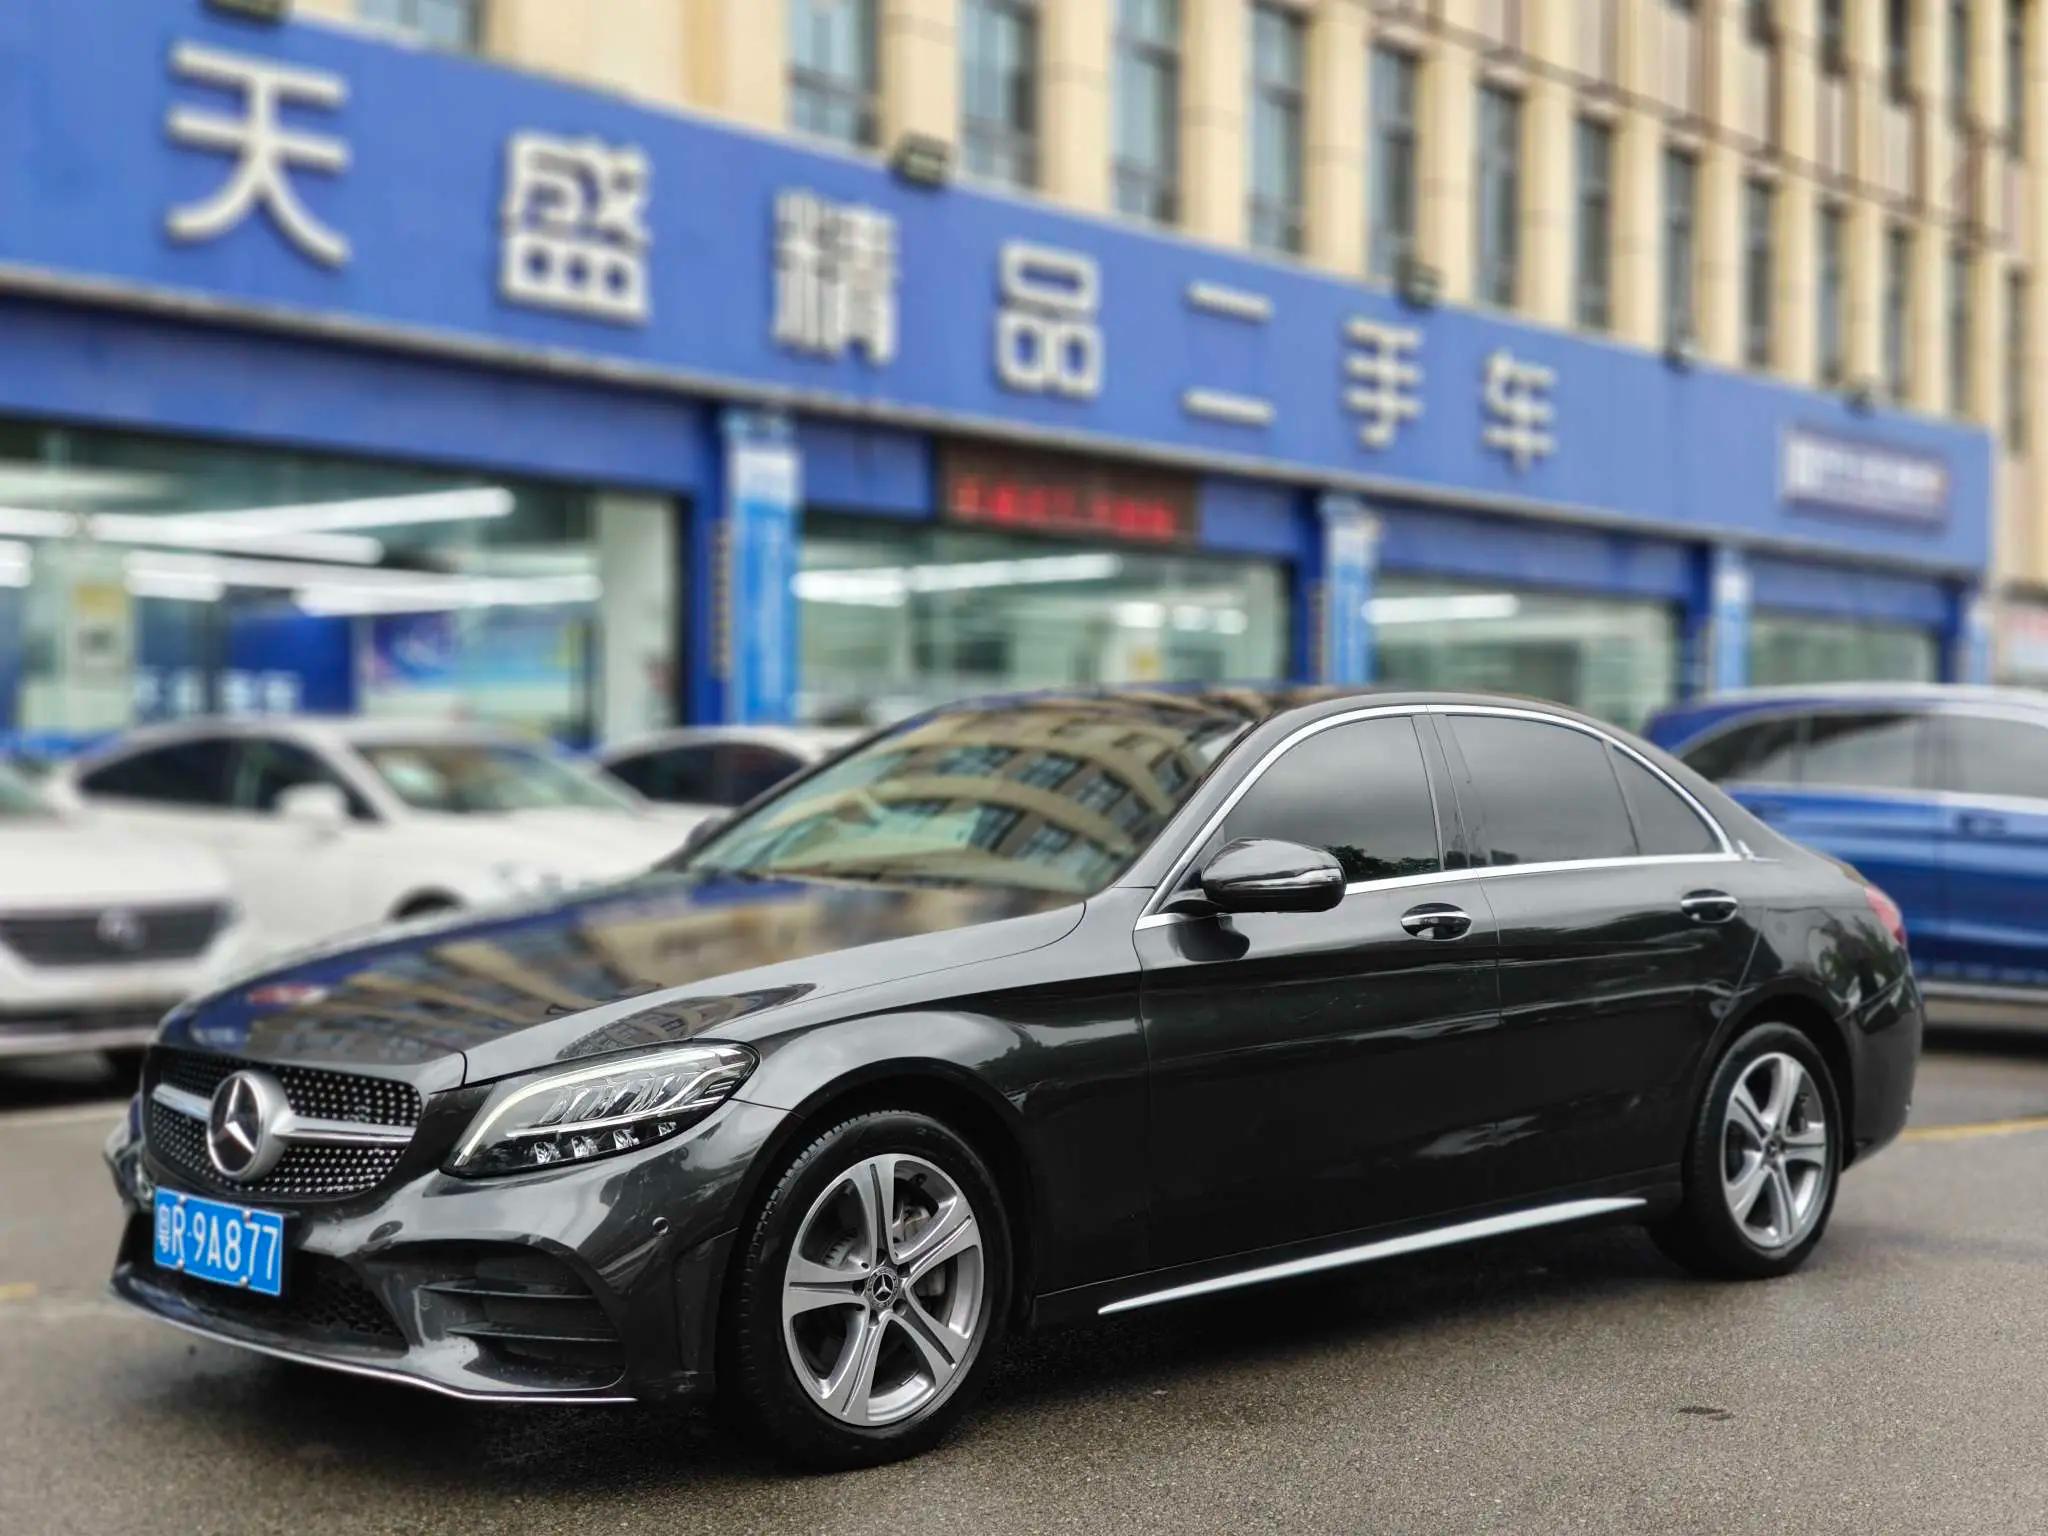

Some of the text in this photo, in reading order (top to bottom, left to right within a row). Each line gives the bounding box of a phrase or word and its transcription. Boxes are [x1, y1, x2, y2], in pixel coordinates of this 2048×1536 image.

[166, 40, 1558, 468] 天盛精品二手车
